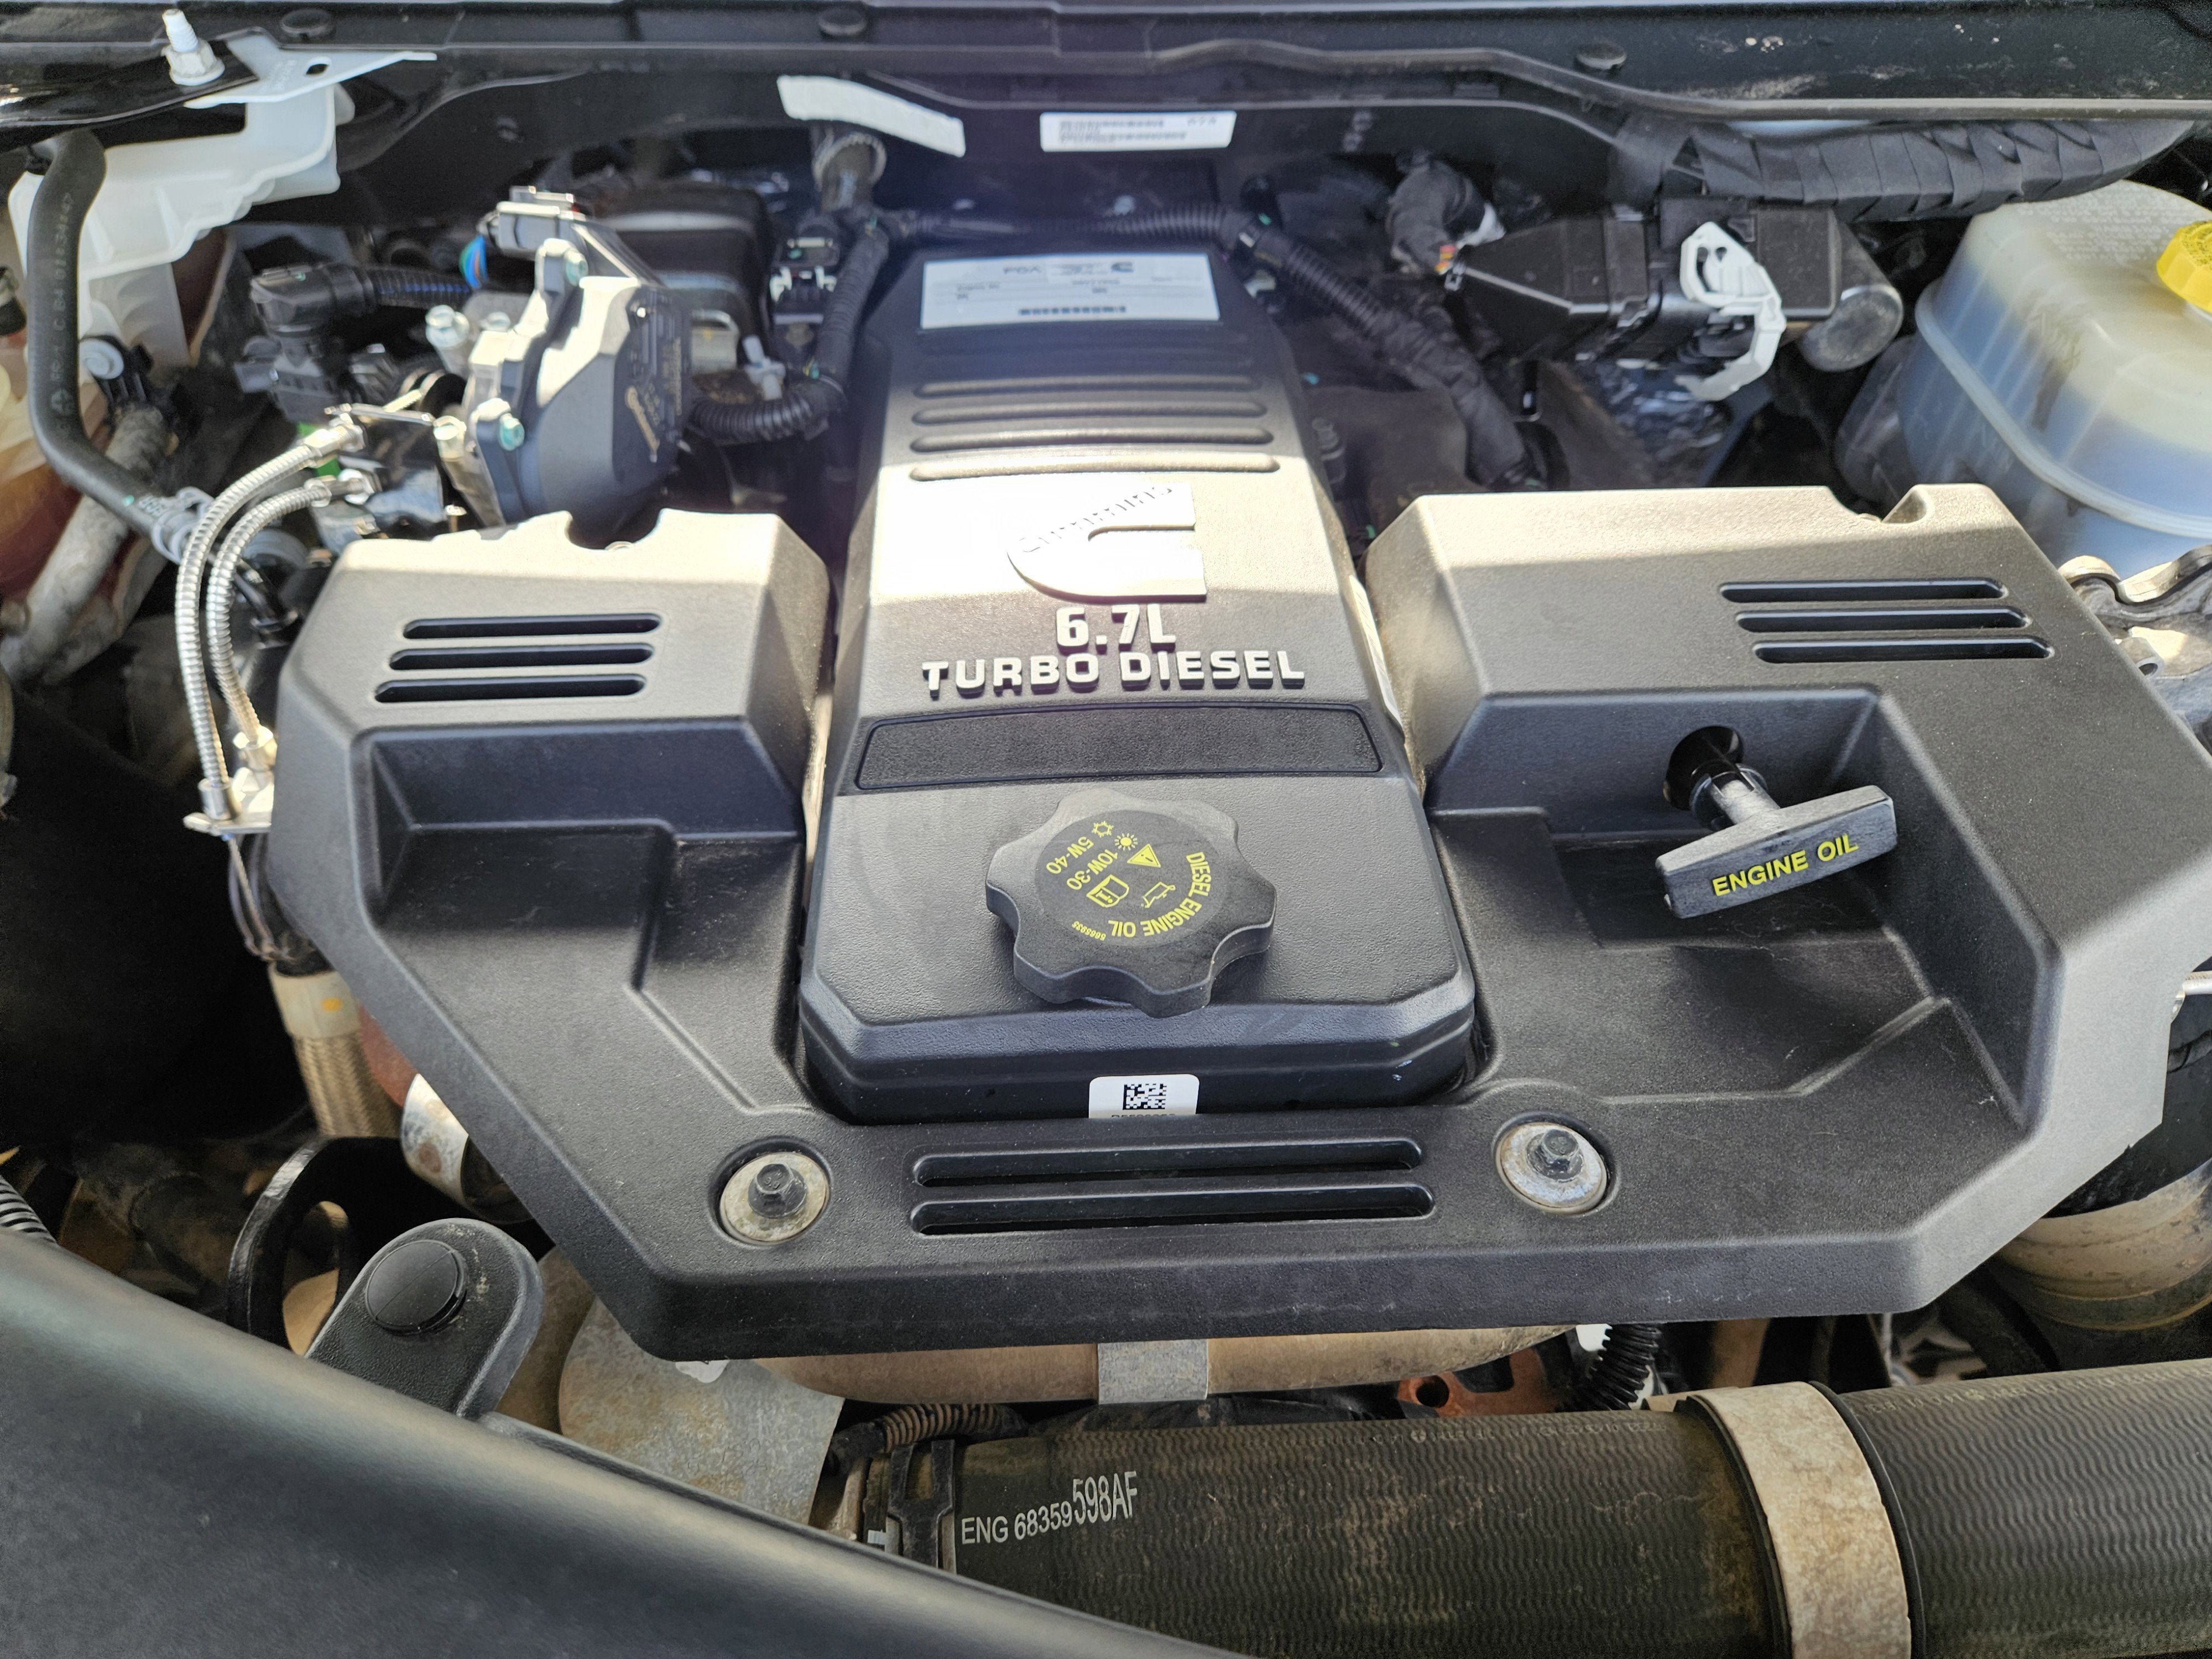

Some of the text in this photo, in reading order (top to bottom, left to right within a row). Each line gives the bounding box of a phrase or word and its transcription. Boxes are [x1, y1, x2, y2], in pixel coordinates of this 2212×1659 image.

[1056, 603, 1176, 650] 6.7L
[922, 650, 1305, 696] TURBO DIESEL
[1046, 836, 1094, 874] 5W-40
[1066, 848, 1118, 891] 10W-30
[1712, 834, 1859, 896] ENGINE OIL
[1108, 852, 1212, 938] DIESEL ENGINE OIL
[961, 1471, 1138, 1545] ENG 68359598AF
